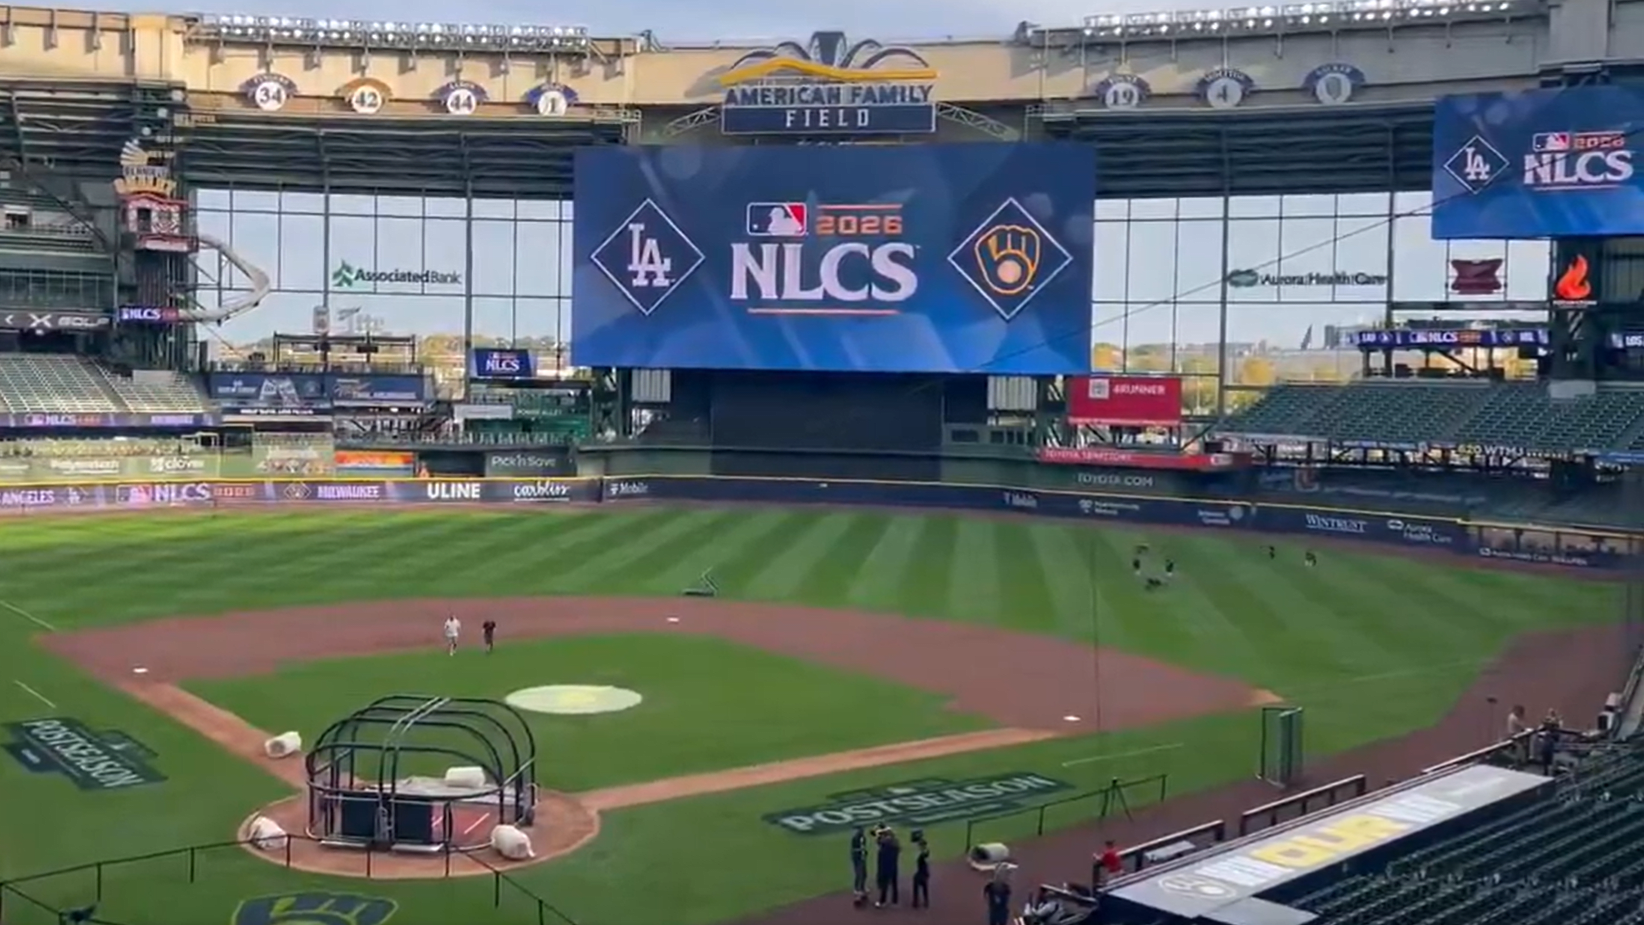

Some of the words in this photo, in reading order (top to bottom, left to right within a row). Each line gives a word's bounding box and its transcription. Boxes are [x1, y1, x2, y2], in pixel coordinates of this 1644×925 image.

[259, 86, 282, 104] 34
[355, 91, 378, 108] 42
[725, 84, 841, 106] AMERICAN
[850, 83, 935, 105] FAMILY
[1112, 88, 1134, 106] 19
[1216, 83, 1228, 103] 4
[450, 94, 473, 111] 44
[785, 108, 870, 128] FIELD
[1464, 146, 1491, 181] LA
[1523, 150, 1634, 185] NLCS
[815, 215, 903, 235] 2026
[627, 223, 671, 288] LA
[354, 268, 430, 283] Associated
[430, 270, 462, 285] Bank
[730, 241, 918, 302] NLCS
[1260, 273, 1304, 286] Aurora
[1308, 270, 1350, 286] Health
[1354, 271, 1386, 286] Care
[57, 315, 110, 327] GOLF
[129, 307, 162, 320] NLCS
[1428, 332, 1459, 343] NLCS
[485, 358, 520, 372] NLCS
[1, 489, 55, 505] ANGELES
[154, 482, 210, 503] NLCS
[316, 485, 380, 500] MILWAUKEE
[426, 483, 481, 500] ULINE
[21, 719, 145, 788] POSTSEASON
[780, 773, 1058, 832] POSTSEASON
